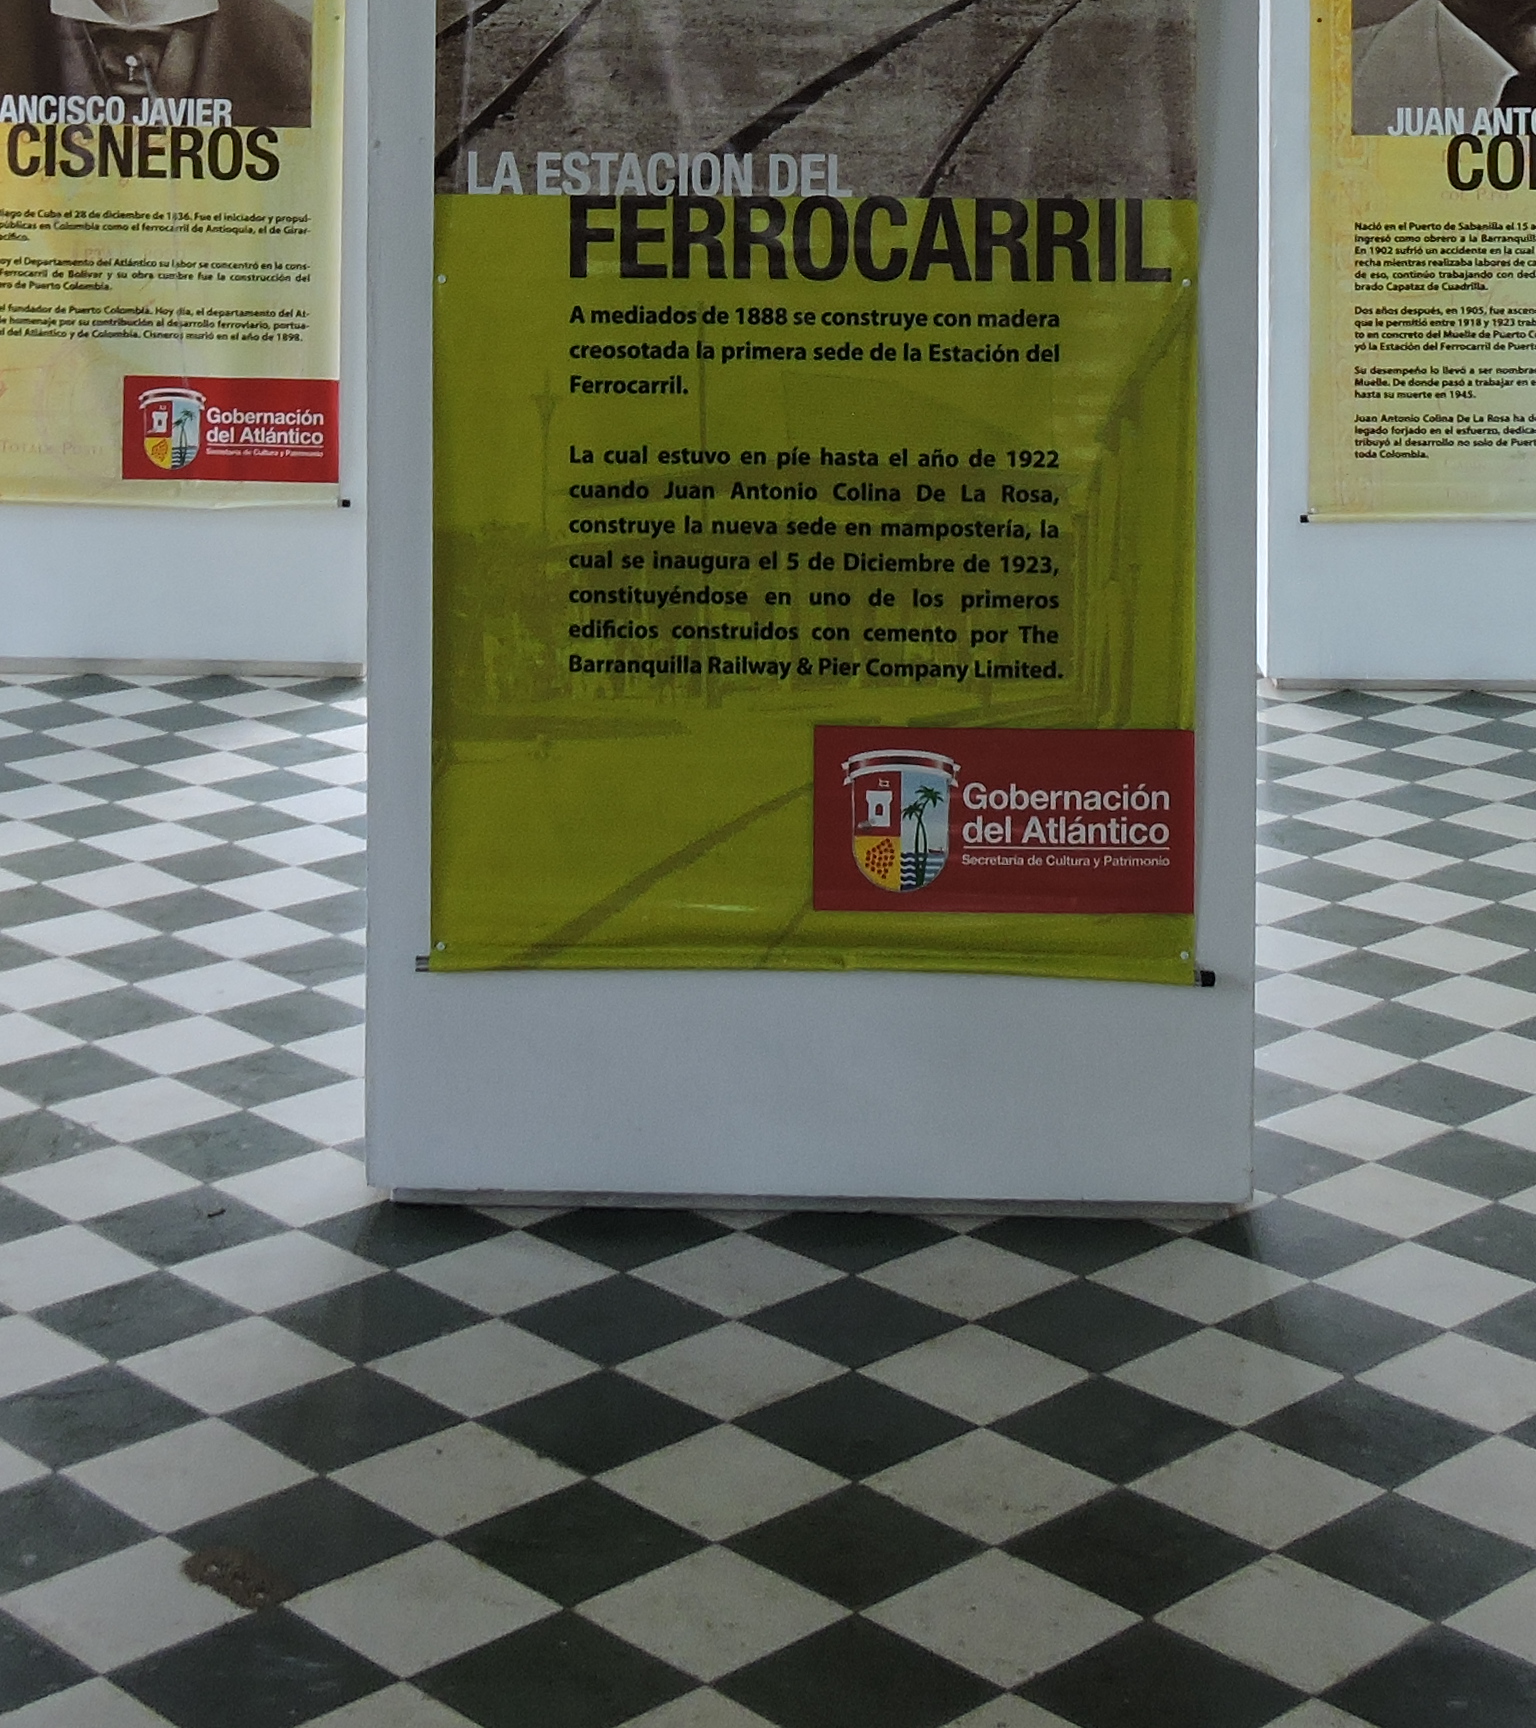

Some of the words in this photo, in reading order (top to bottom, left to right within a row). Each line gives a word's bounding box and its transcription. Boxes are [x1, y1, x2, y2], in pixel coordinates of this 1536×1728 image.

[132, 97, 233, 127] JAVIER
[1386, 106, 1465, 136] JUAN
[7, 123, 280, 181] CISNEROS
[467, 150, 524, 195] LA
[536, 150, 754, 197] ESTACION
[768, 153, 853, 198] DEL
[568, 193, 1173, 283] FERROCARRIL
[570, 306, 585, 325] A
[590, 306, 696, 326] mediados
[702, 307, 729, 326] de
[735, 307, 787, 327] 1888
[793, 312, 815, 327] se
[821, 308, 927, 332] construye
[933, 313, 971, 328] con
[977, 309, 1060, 328] madera
[570, 341, 689, 360] creosotada
[696, 341, 714, 361] la
[721, 342, 806, 366] primera
[813, 342, 863, 362] sede
[869, 342, 896, 362] de
[903, 343, 921, 362] la
[928, 343, 1019, 363] Estación
[1025, 344, 1060, 363] del
[1368, 342, 1377, 351] la
[1379, 342, 1420, 351] Estación
[1422, 342, 1437, 351] del
[1439, 342, 1490, 351] Ferrocarril
[1492, 342, 1505, 351] de
[570, 375, 688, 395] Ferrocarril.
[206, 406, 324, 426] Gobernación
[206, 427, 234, 443] del
[239, 427, 324, 445] Atlántico
[570, 445, 593, 465] La
[603, 445, 647, 465] cual
[657, 446, 730, 466] estuvo
[740, 451, 766, 466] en
[777, 447, 810, 471] píe
[820, 447, 878, 467] hasta
[888, 448, 907, 467] el
[917, 448, 958, 468] año
[968, 448, 995, 468] de
[1006, 449, 1059, 468] 1922
[570, 481, 648, 500] cuando
[664, 481, 714, 501] Juan
[730, 482, 817, 501] Antonio
[833, 482, 900, 502] Colina
[916, 483, 945, 502] De
[961, 483, 985, 503] La
[1001, 483, 1059, 506] Rosa,
[962, 782, 1170, 811] Gobernación
[962, 815, 1012, 844] del
[1021, 815, 1170, 845] Atlántico
[1027, 854, 1043, 866] de
[1045, 854, 1091, 867] Cultura
[1093, 858, 1101, 869] y
[1103, 855, 1170, 867] Patrimonio
